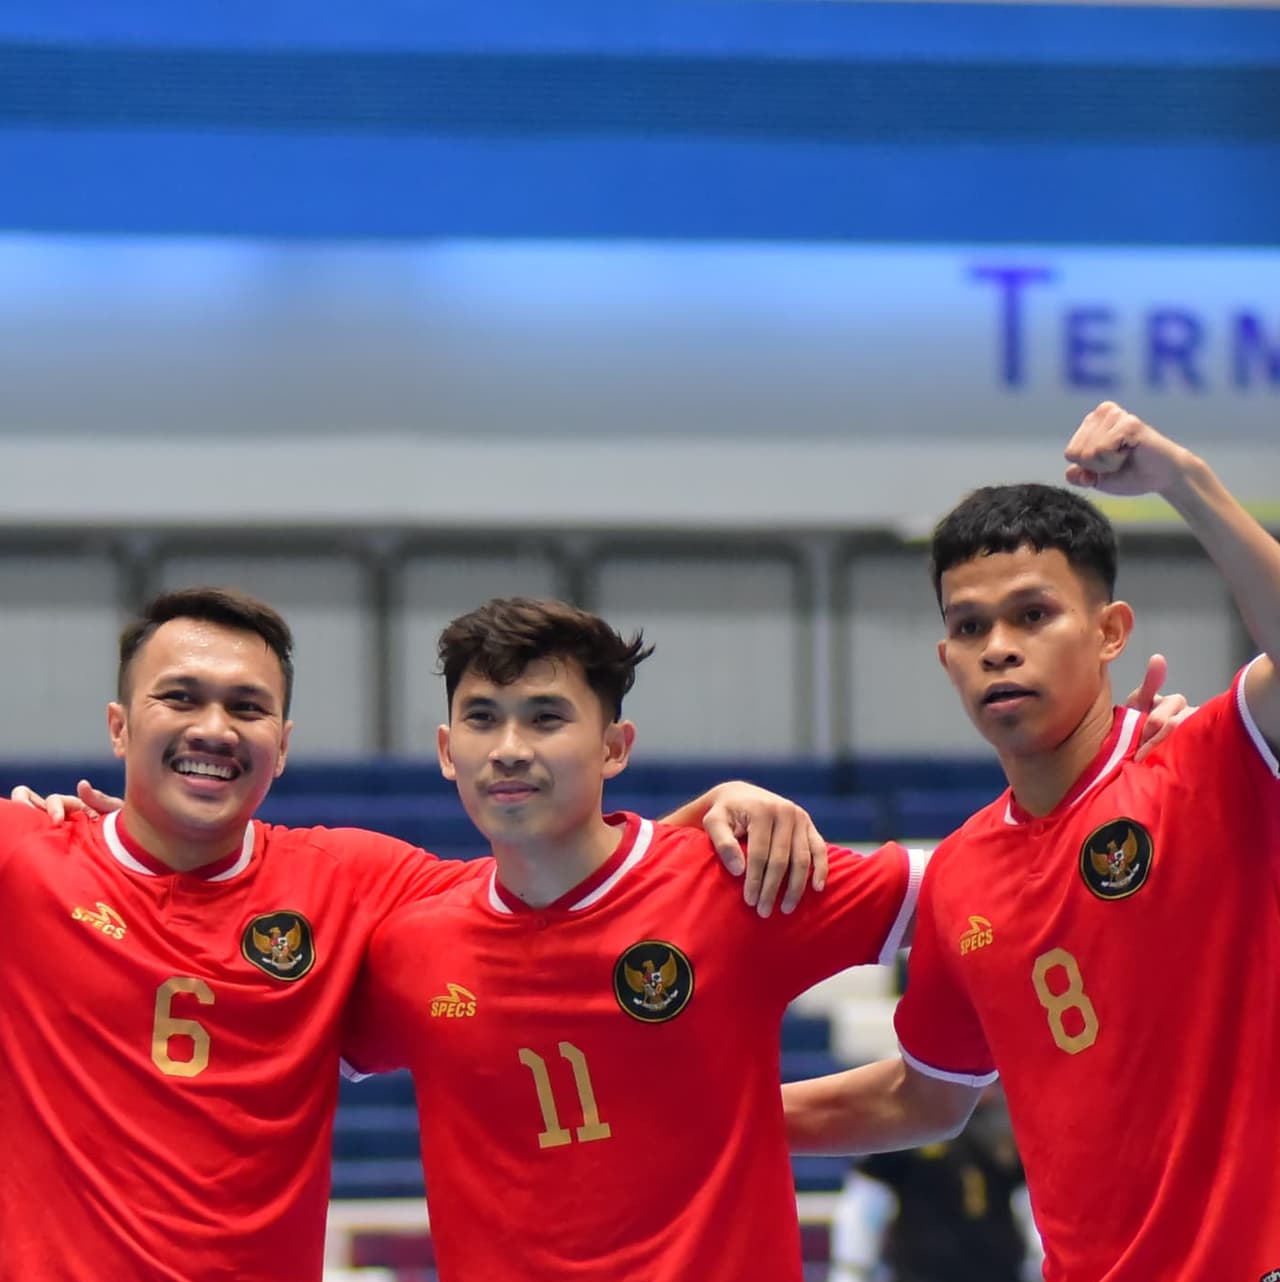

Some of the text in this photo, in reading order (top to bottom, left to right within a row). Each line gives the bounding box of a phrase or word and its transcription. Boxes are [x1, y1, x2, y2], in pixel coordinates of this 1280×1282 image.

[71, 907, 126, 940] SPECS
[960, 929, 993, 956] SPECS
[151, 977, 216, 1078] 6
[431, 1001, 476, 1018] SPECS
[1032, 947, 1099, 1055] 8
[518, 1041, 612, 1149] 11
